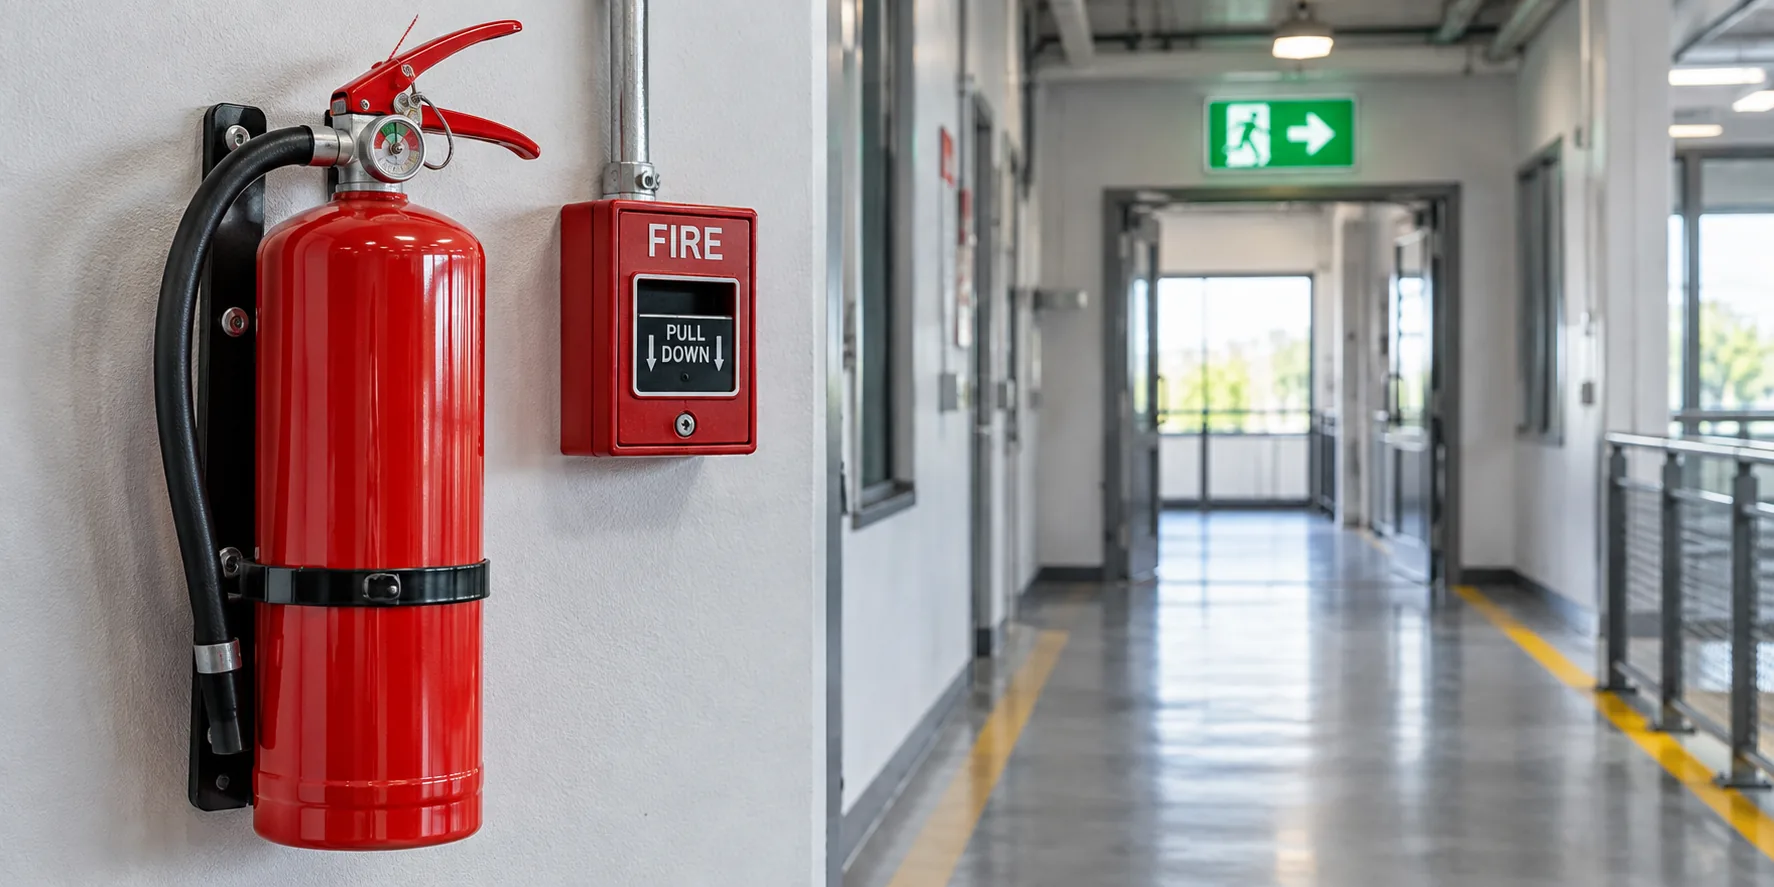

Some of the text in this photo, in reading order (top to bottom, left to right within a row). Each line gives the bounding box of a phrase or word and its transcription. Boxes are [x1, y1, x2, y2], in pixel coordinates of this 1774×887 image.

[648, 223, 723, 261] FIRE
[666, 324, 706, 342] PULL
[661, 345, 710, 364] DOWN
